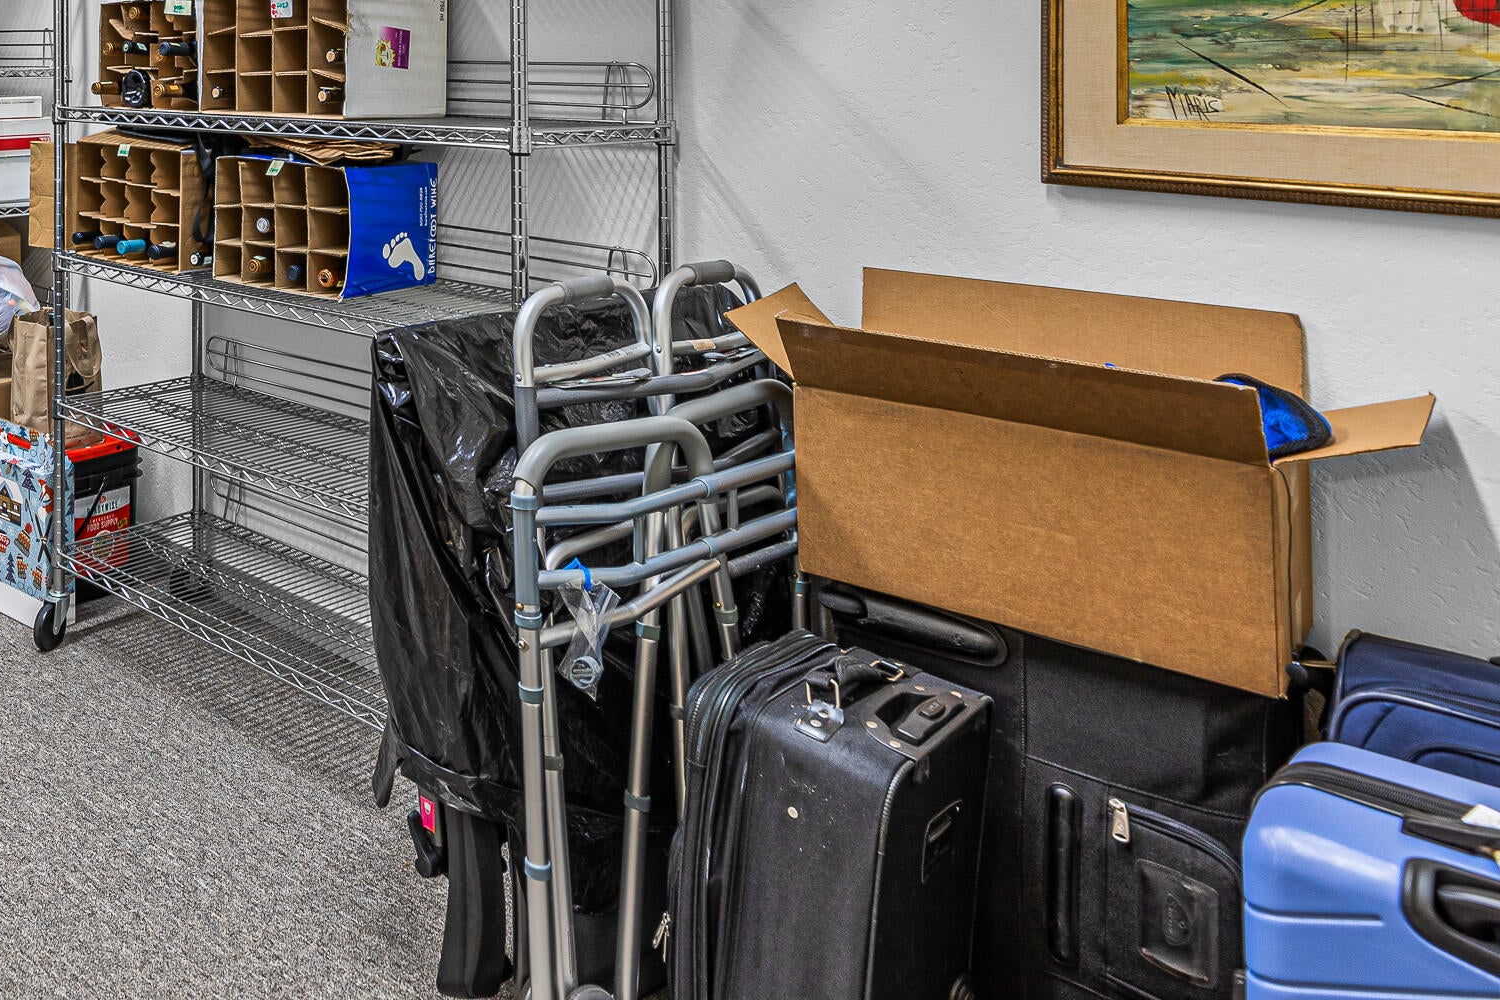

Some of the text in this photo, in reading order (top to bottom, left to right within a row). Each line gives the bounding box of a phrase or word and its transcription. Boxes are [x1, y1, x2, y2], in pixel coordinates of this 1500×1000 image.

[427, 177, 438, 274] BAREFOOT WINE
[86, 517, 118, 532] FOOD SUPPLY
